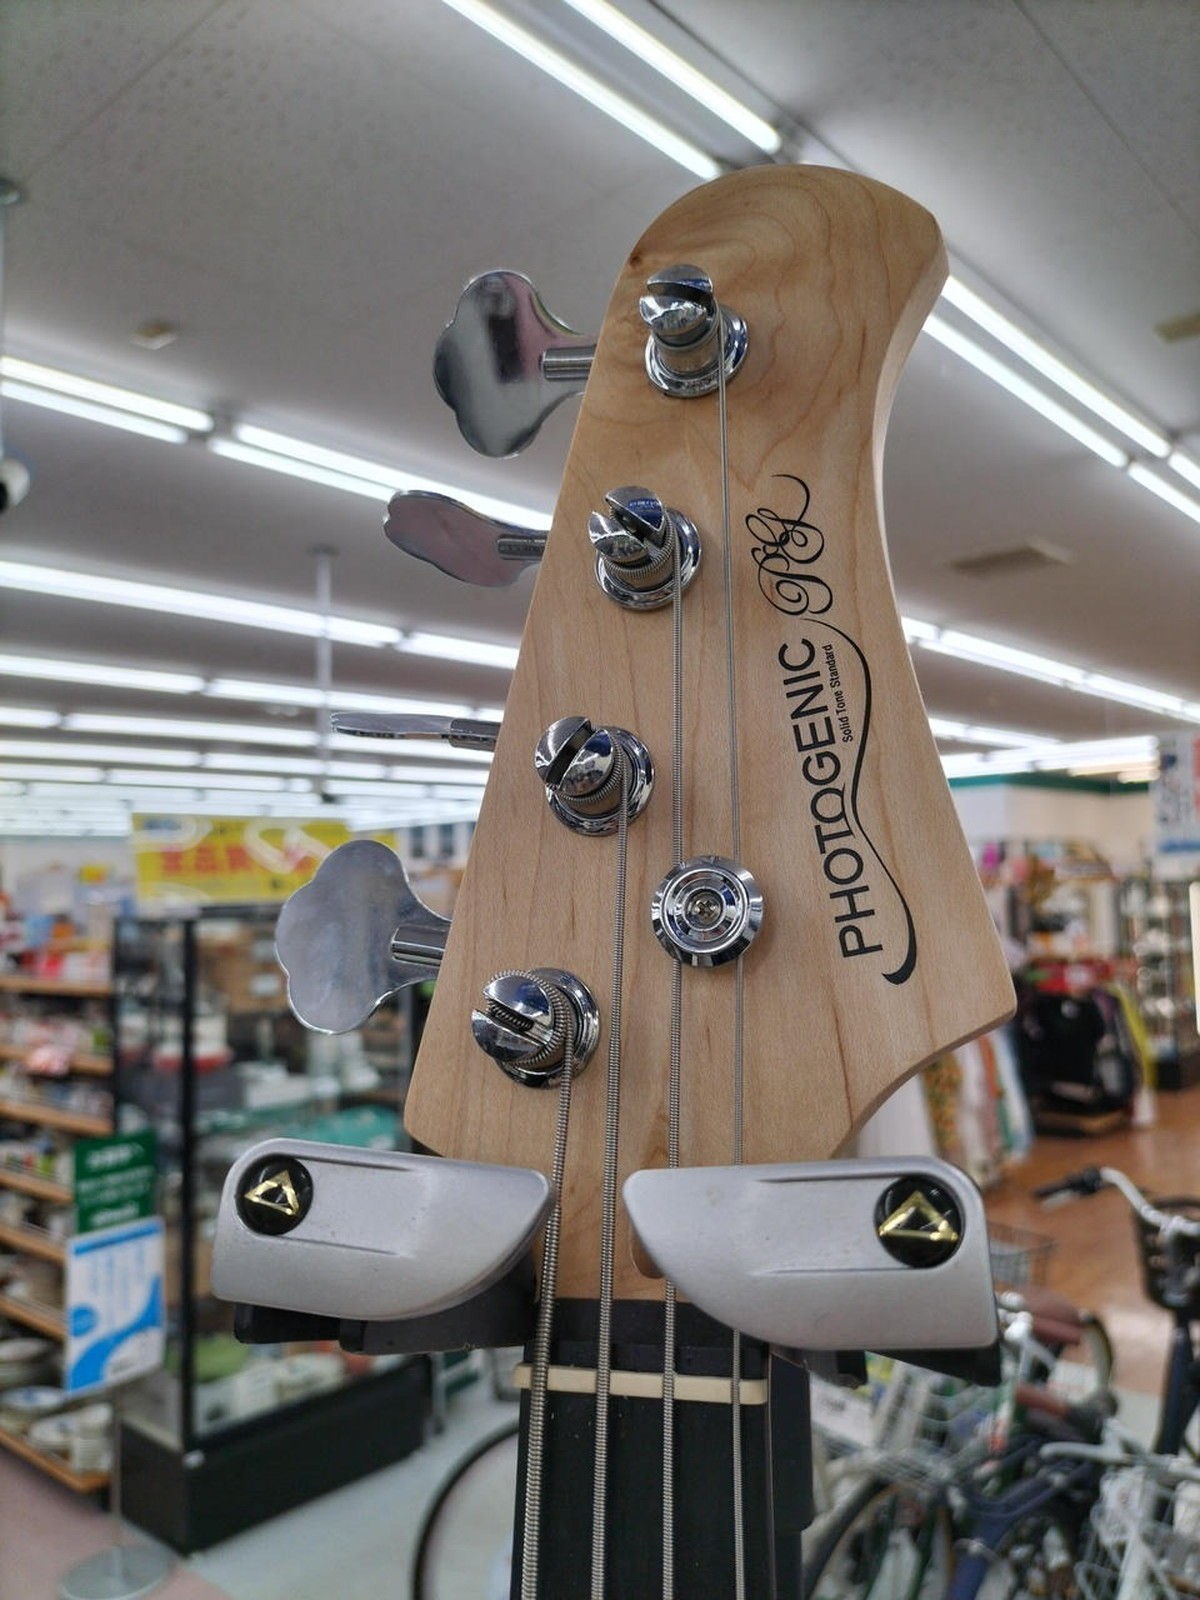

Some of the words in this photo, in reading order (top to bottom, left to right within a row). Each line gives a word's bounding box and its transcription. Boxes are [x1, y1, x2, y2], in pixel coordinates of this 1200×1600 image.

[821, 643, 841, 689] Standard
[834, 690, 847, 716] Tone
[838, 716, 854, 743] Solid
[777, 638, 884, 958] PHOTOGENIC
